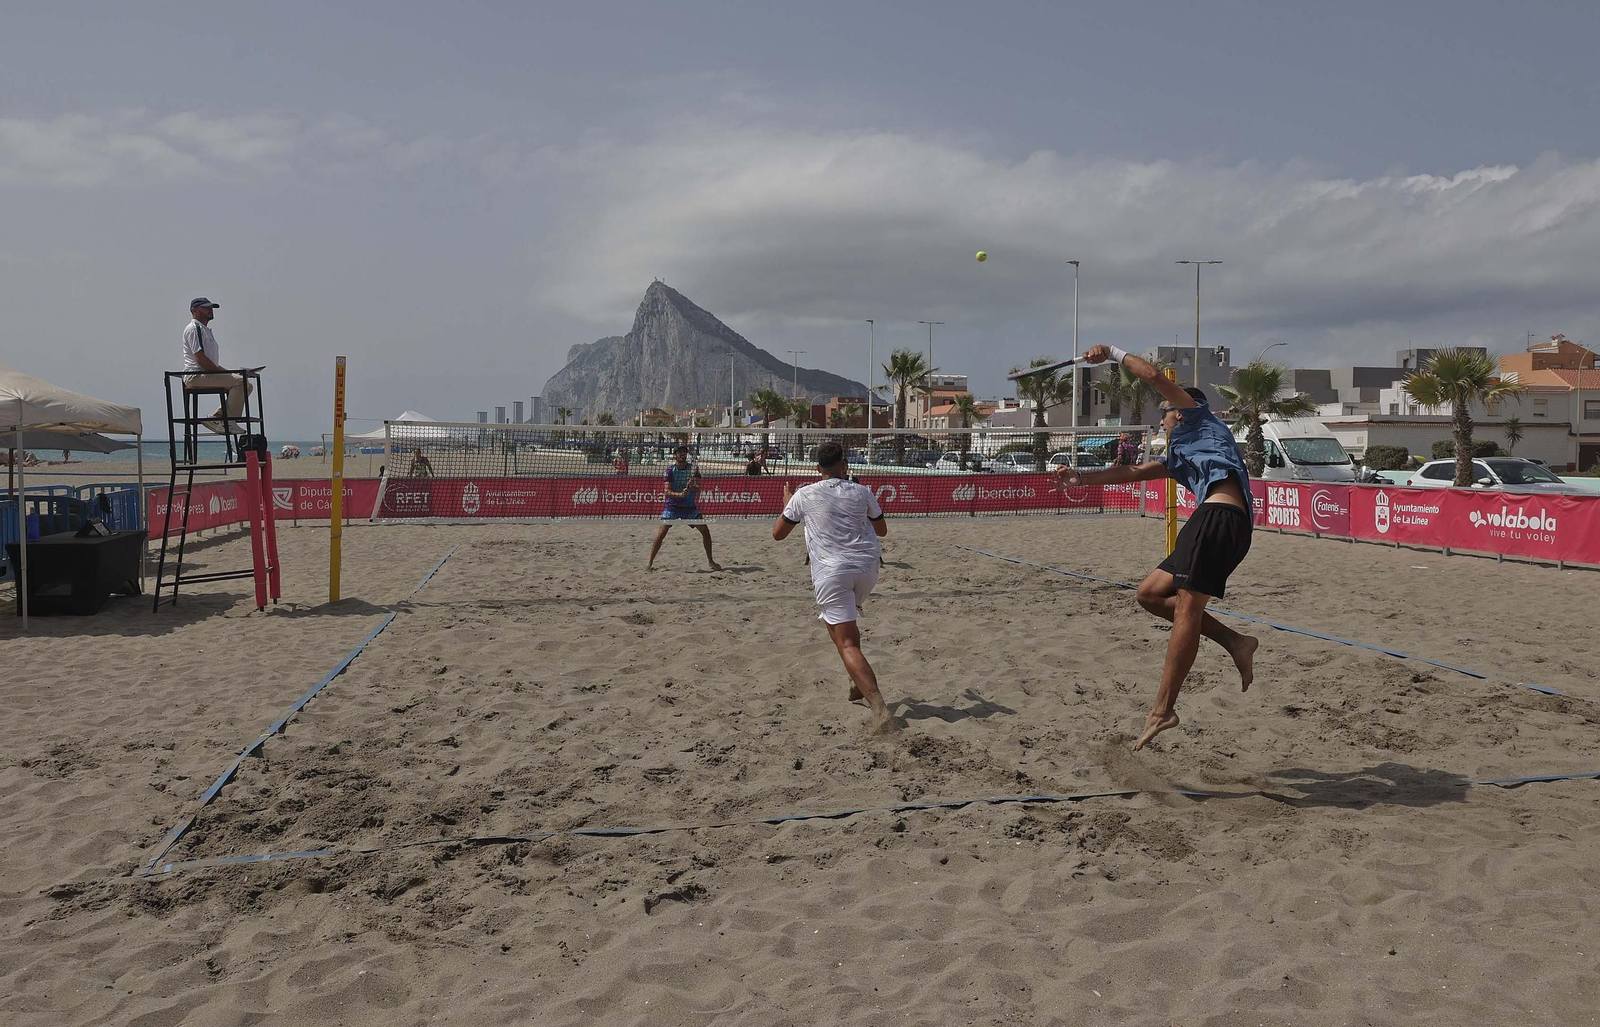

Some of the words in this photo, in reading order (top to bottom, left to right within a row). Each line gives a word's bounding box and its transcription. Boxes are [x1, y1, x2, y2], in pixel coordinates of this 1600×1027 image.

[299, 486, 353, 498] Diputaón
[396, 492, 430, 504] RFET
[300, 500, 313, 510] de
[1252, 497, 1264, 508] FET
[1392, 502, 1440, 514] Ayuntamiento
[1268, 506, 1300, 527] SPORTS
[1392, 513, 1402, 523] de
[1402, 514, 1411, 524] La
[1486, 505, 1557, 532] volabola
[1489, 527, 1507, 538] vive
[1510, 529, 1522, 540] tu
[1526, 531, 1557, 545] voley
